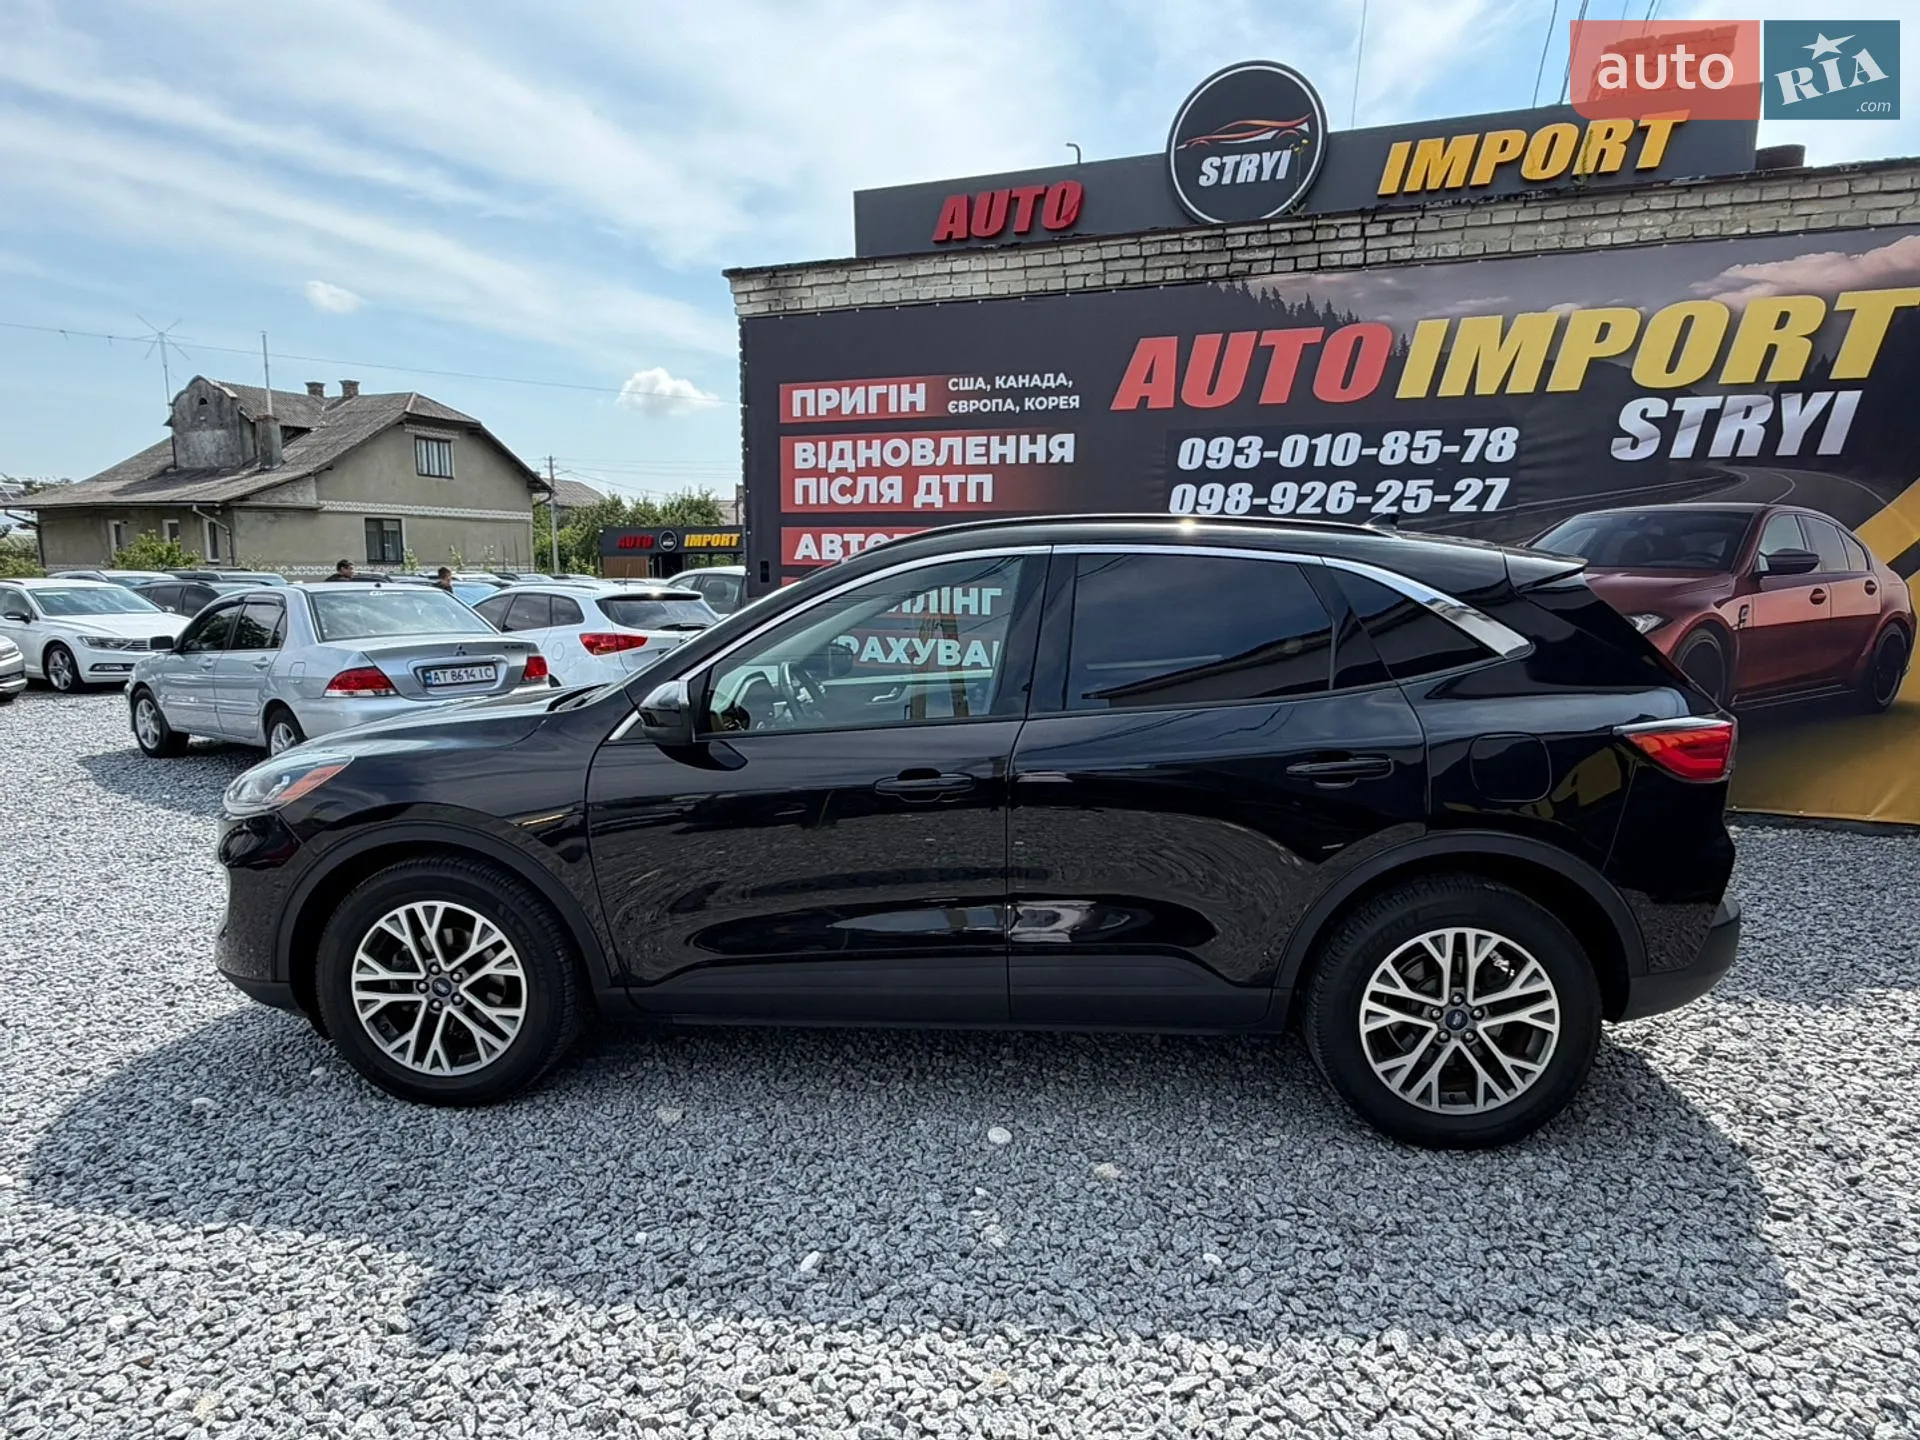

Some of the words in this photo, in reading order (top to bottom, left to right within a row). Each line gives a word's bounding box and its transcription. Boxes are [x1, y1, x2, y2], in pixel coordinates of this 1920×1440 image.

[932, 180, 1085, 243] AUTO
[1377, 109, 1690, 195] IMPORT
[1198, 149, 1293, 187] STRYI
[791, 382, 926, 417] ПРИГІН
[947, 377, 991, 393] США,
[994, 372, 1074, 390] КАНАДА,
[947, 398, 1020, 415] ЄВРОПА,
[1024, 395, 1080, 412] КОРЕЯ
[1610, 390, 1863, 461] STRYI
[794, 433, 1076, 473] ВІДНОВЛЕННЯ
[1176, 426, 1520, 471] 093-010-85-78
[794, 476, 903, 505] ПІСЛЯ
[913, 474, 994, 508] ДТП
[1168, 477, 1512, 516] 098-926-25-27
[616, 534, 656, 549] AUTO
[683, 532, 741, 548] IMPORT
[794, 532, 909, 561] АВТ
[832, 634, 1000, 668] РАХУВА
